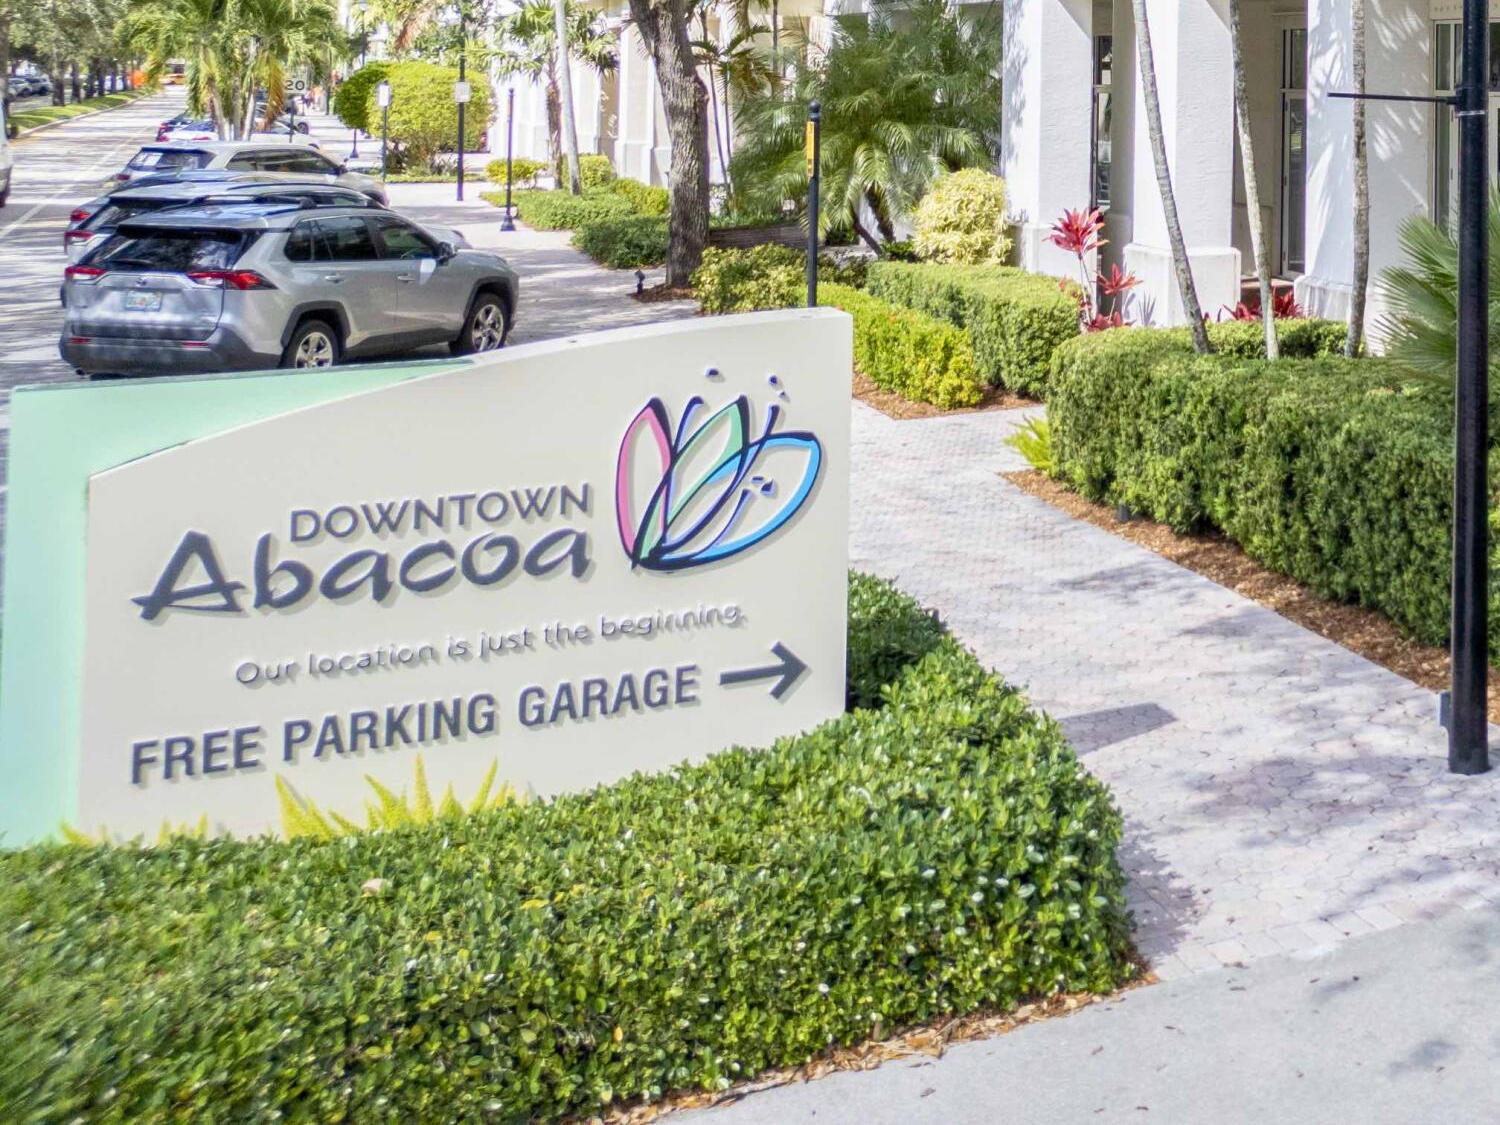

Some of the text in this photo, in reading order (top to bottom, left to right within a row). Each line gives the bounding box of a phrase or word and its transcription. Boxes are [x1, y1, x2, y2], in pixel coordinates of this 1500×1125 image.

[284, 79, 305, 91] 20
[290, 482, 590, 542] DOWNTOWN
[130, 527, 591, 621] Abacoa
[236, 660, 299, 685] Our
[308, 643, 436, 675] location
[447, 636, 470, 658] is
[478, 627, 533, 657] just
[543, 622, 589, 644] the
[129, 664, 698, 785] FREE PARKING GARAGE
